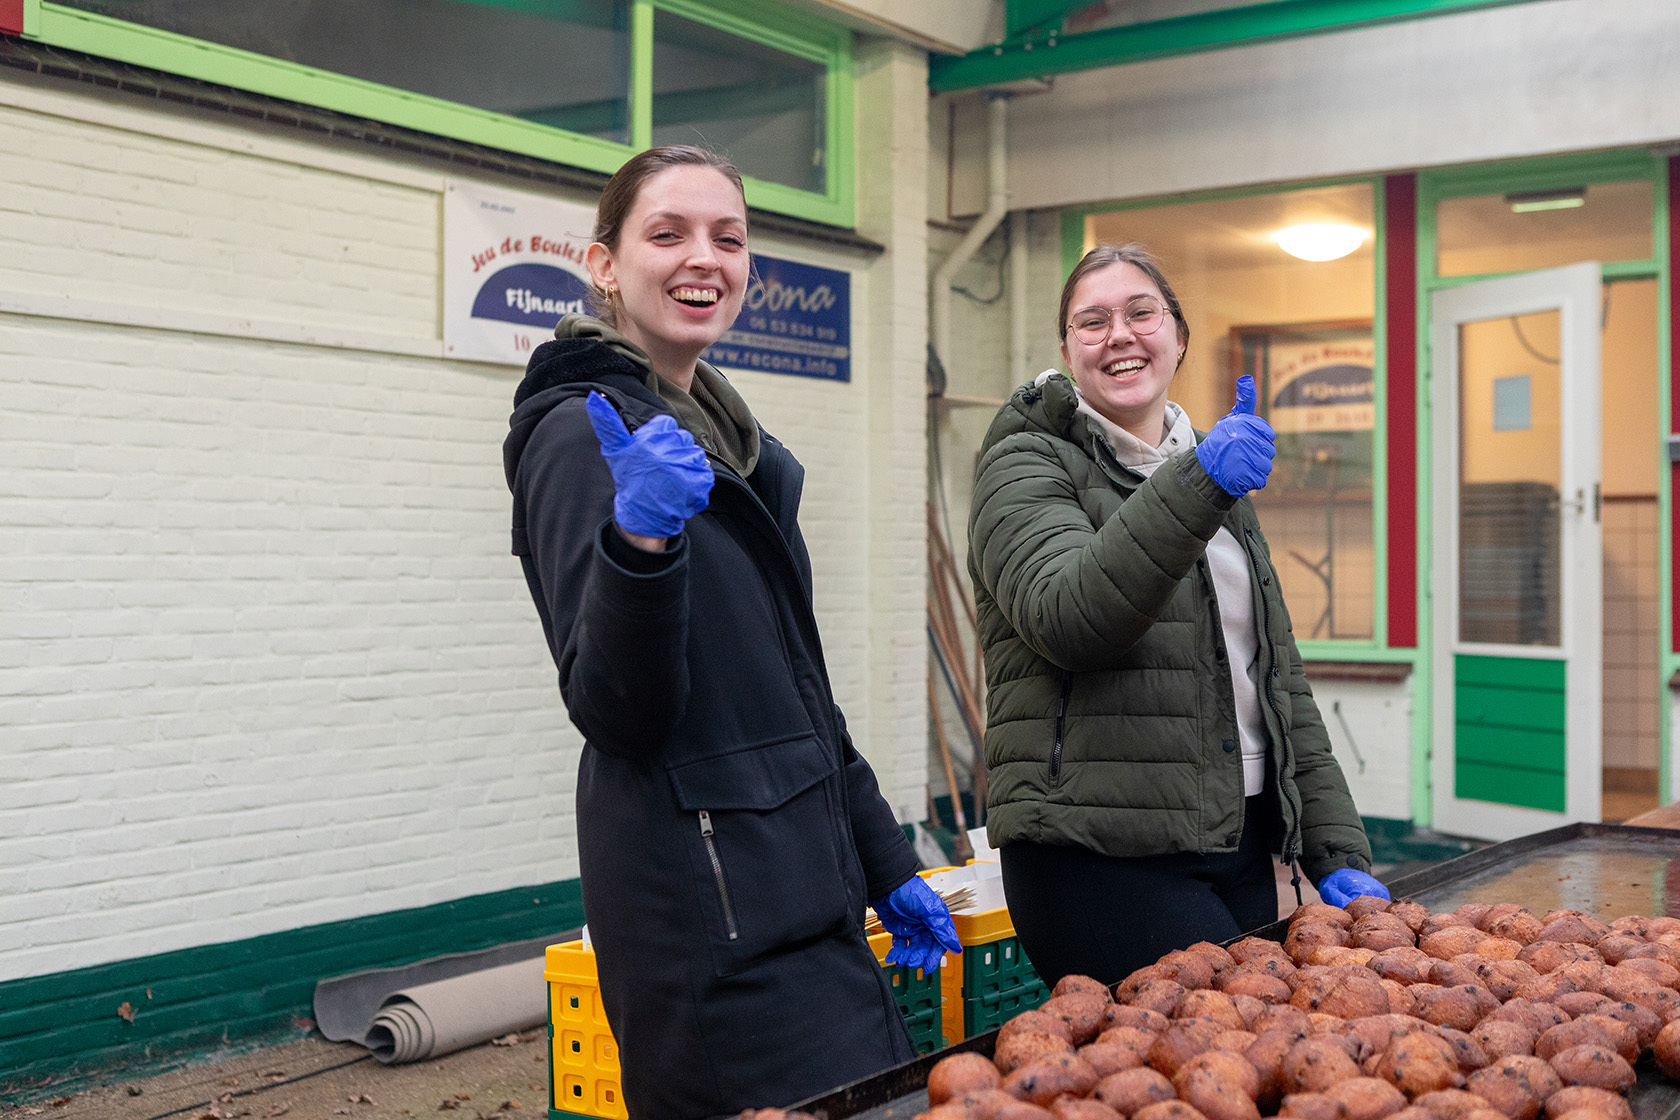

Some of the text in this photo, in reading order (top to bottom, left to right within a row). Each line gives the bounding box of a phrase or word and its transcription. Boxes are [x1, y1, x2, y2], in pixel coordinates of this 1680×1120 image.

[471, 246, 496, 273] Jeu
[500, 237, 522, 256] de
[744, 282, 836, 312] cona
[513, 333, 530, 352] 10
